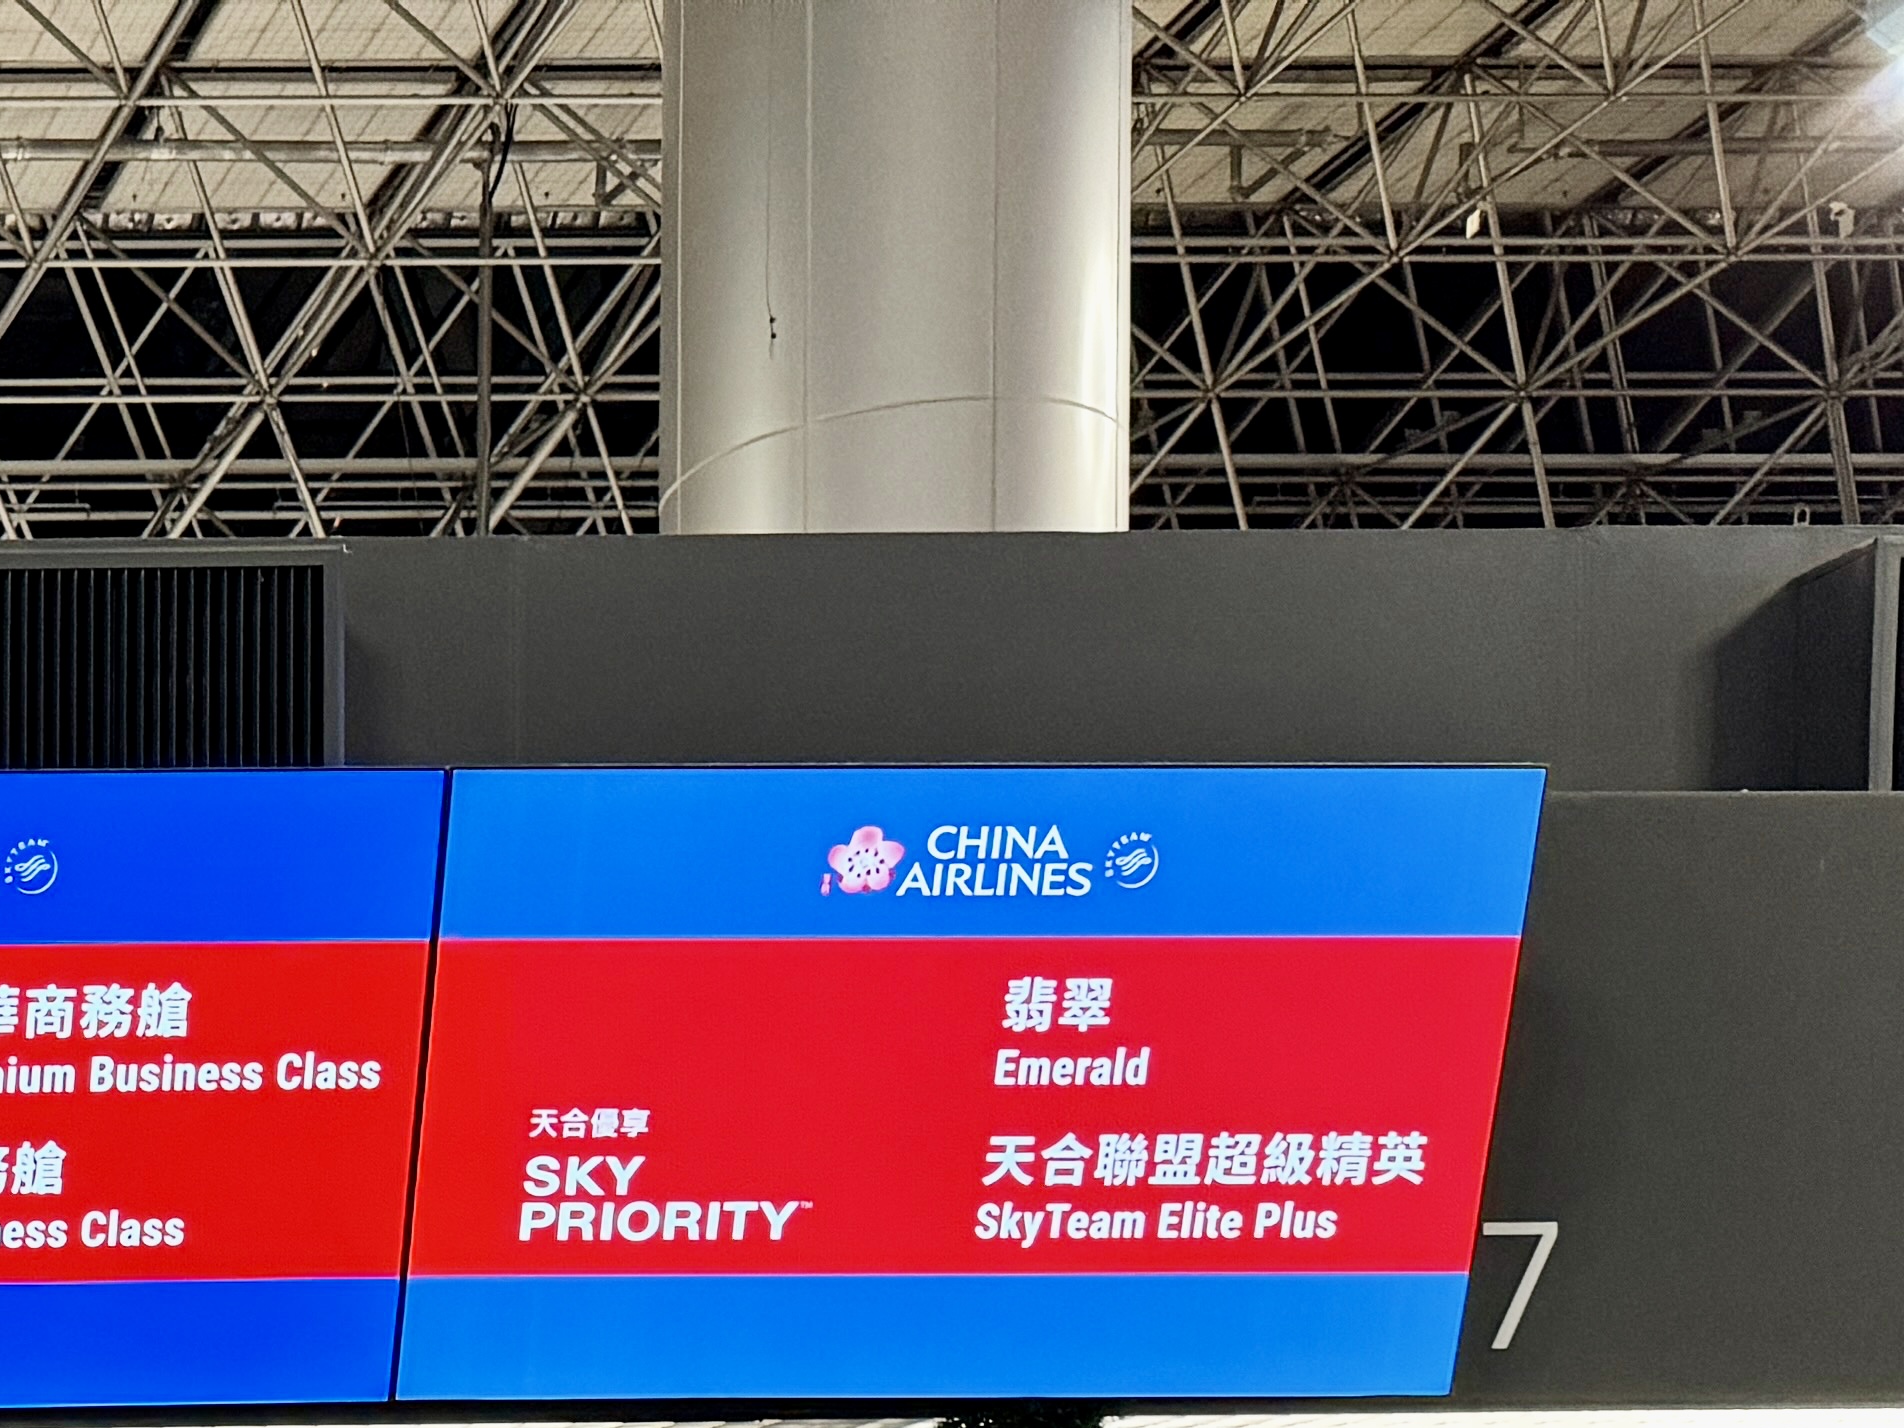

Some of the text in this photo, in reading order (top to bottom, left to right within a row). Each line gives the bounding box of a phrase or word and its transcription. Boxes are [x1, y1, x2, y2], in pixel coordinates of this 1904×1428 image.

[927, 824, 1069, 860] CHINA
[896, 861, 1093, 897] AIRLINES
[1001, 976, 1113, 1033] 翡翠
[89, 1053, 264, 1093] Business
[276, 1050, 382, 1091] Class
[993, 1047, 1151, 1086] Emerald
[529, 1107, 651, 1139] 天合優享
[523, 1155, 646, 1197] SKY
[981, 1130, 1429, 1187] 天合聯盟超級精英
[80, 1208, 185, 1248] Class
[974, 1200, 1339, 1249] SkyTeam Elite Plus
[1482, 1221, 1559, 1350] 7
